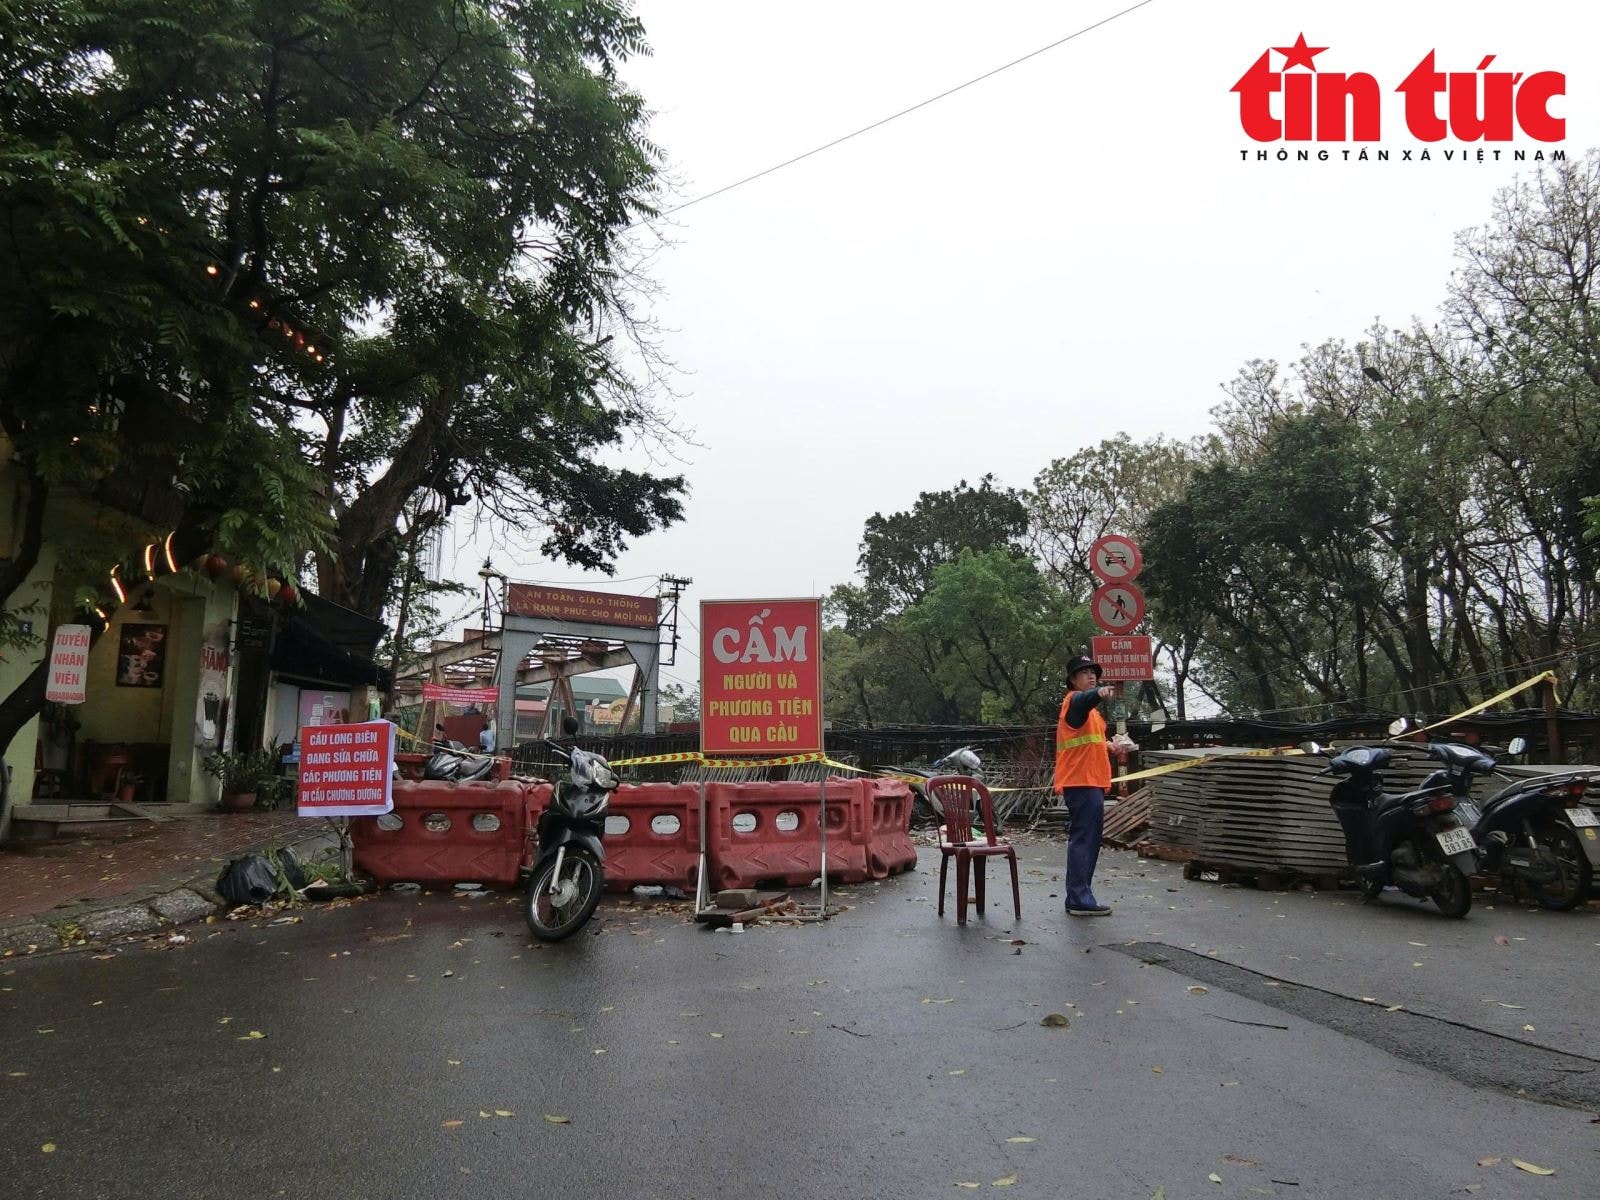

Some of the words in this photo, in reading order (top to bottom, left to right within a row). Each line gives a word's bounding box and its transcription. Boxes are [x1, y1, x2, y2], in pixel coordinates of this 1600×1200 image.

[526, 590, 542, 600] AN
[547, 590, 574, 602] TOÀN
[579, 595, 603, 605] GIAO
[608, 597, 641, 609] THÔNG
[592, 609, 610, 618] CHO
[614, 611, 632, 622] MỌI
[635, 612, 654, 623] NHÀ
[713, 608, 808, 663] CẤM
[53, 652, 85, 666] NHÂN
[54, 670, 80, 685] VIÊN
[723, 671, 772, 690] NGƯỜI
[777, 670, 797, 689] VÀ
[709, 699, 773, 717] PHƯƠNG
[778, 697, 812, 719] TIỆN
[330, 733, 352, 745] LONG
[355, 730, 377, 743] BIÊN
[730, 726, 760, 743] QUA
[767, 720, 798, 742] CẦU
[333, 748, 351, 763] SỬA
[354, 749, 379, 762] CHỮA
[303, 769, 320, 783] CÁC
[322, 769, 359, 782] PHƯƠNG
[362, 767, 382, 783] TIỆN
[326, 789, 355, 801] CHƯƠNG
[357, 788, 382, 800] DƯƠNG
